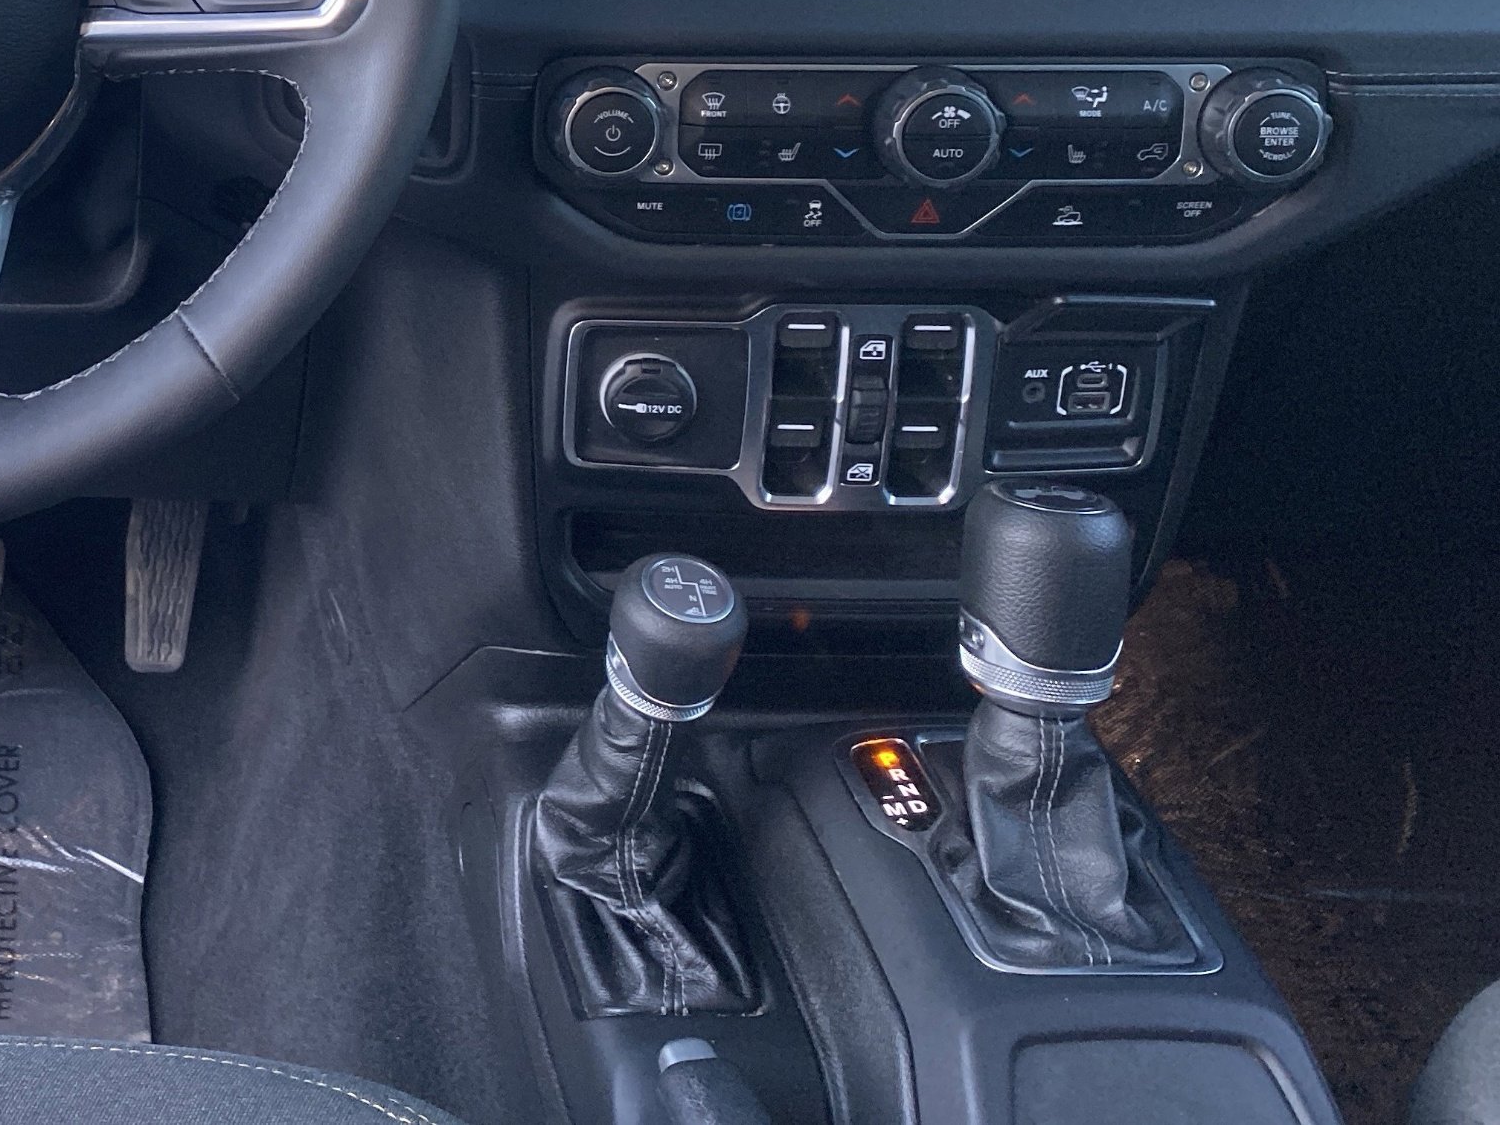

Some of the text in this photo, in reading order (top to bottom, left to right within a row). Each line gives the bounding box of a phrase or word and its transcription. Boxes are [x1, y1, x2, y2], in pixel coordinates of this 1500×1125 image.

[1143, 99, 1168, 112] A/C
[597, 109, 629, 120] VOLUME
[700, 110, 727, 118] FRONT
[1078, 109, 1102, 118] MODE
[938, 118, 961, 130] OFF
[1260, 126, 1299, 135] BROWSE
[1264, 137, 1295, 146] ENTER
[933, 148, 964, 159] AUTO
[636, 202, 664, 211] MUTE
[1176, 201, 1213, 210] SCREEN
[1183, 209, 1203, 218] OFF
[803, 219, 823, 228] OFF
[1024, 368, 1049, 379] AUX
[647, 404, 683, 415] 12V DC
[888, 768, 910, 782] R
[897, 782, 921, 797] N
[882, 802, 908, 817] M
[907, 799, 928, 813] D
